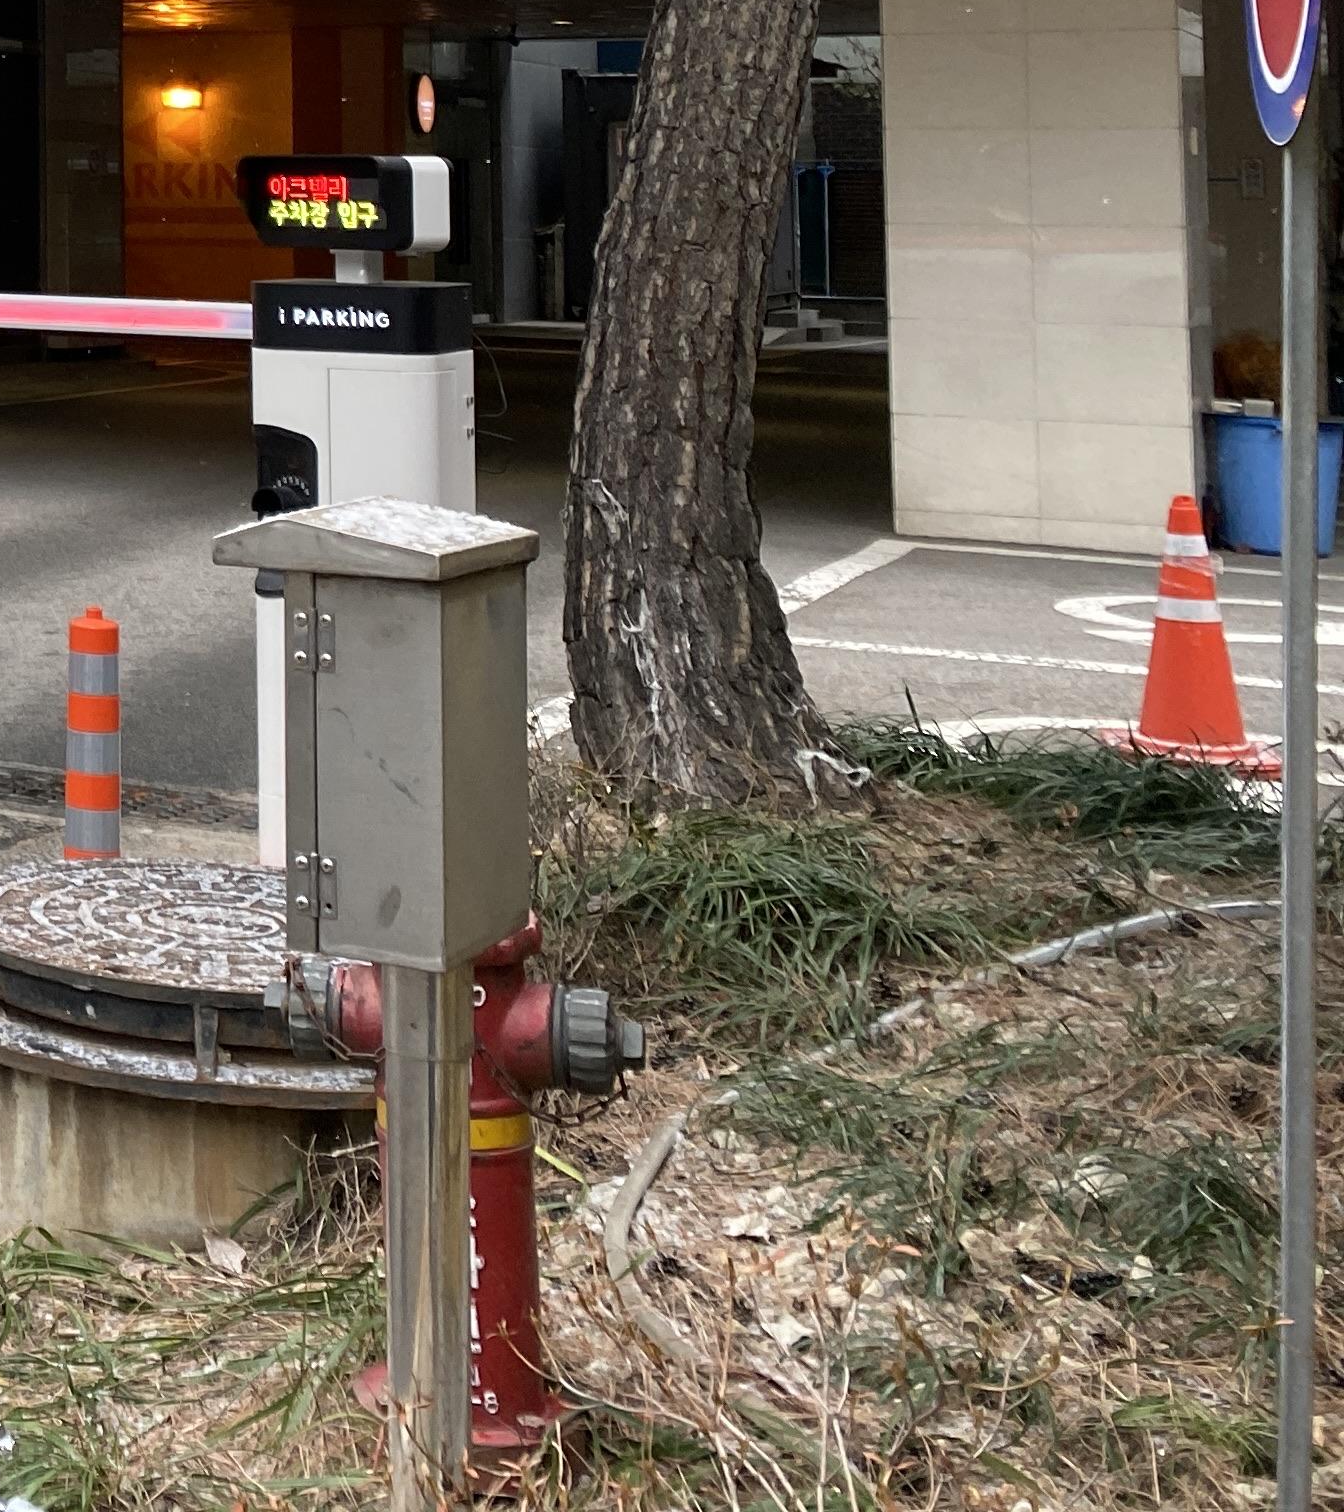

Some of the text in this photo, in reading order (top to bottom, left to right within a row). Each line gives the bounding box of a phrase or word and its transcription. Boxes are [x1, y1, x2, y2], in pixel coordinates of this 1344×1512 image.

[123, 161, 240, 199] RKIN
[269, 200, 379, 229] 주차장 입구
